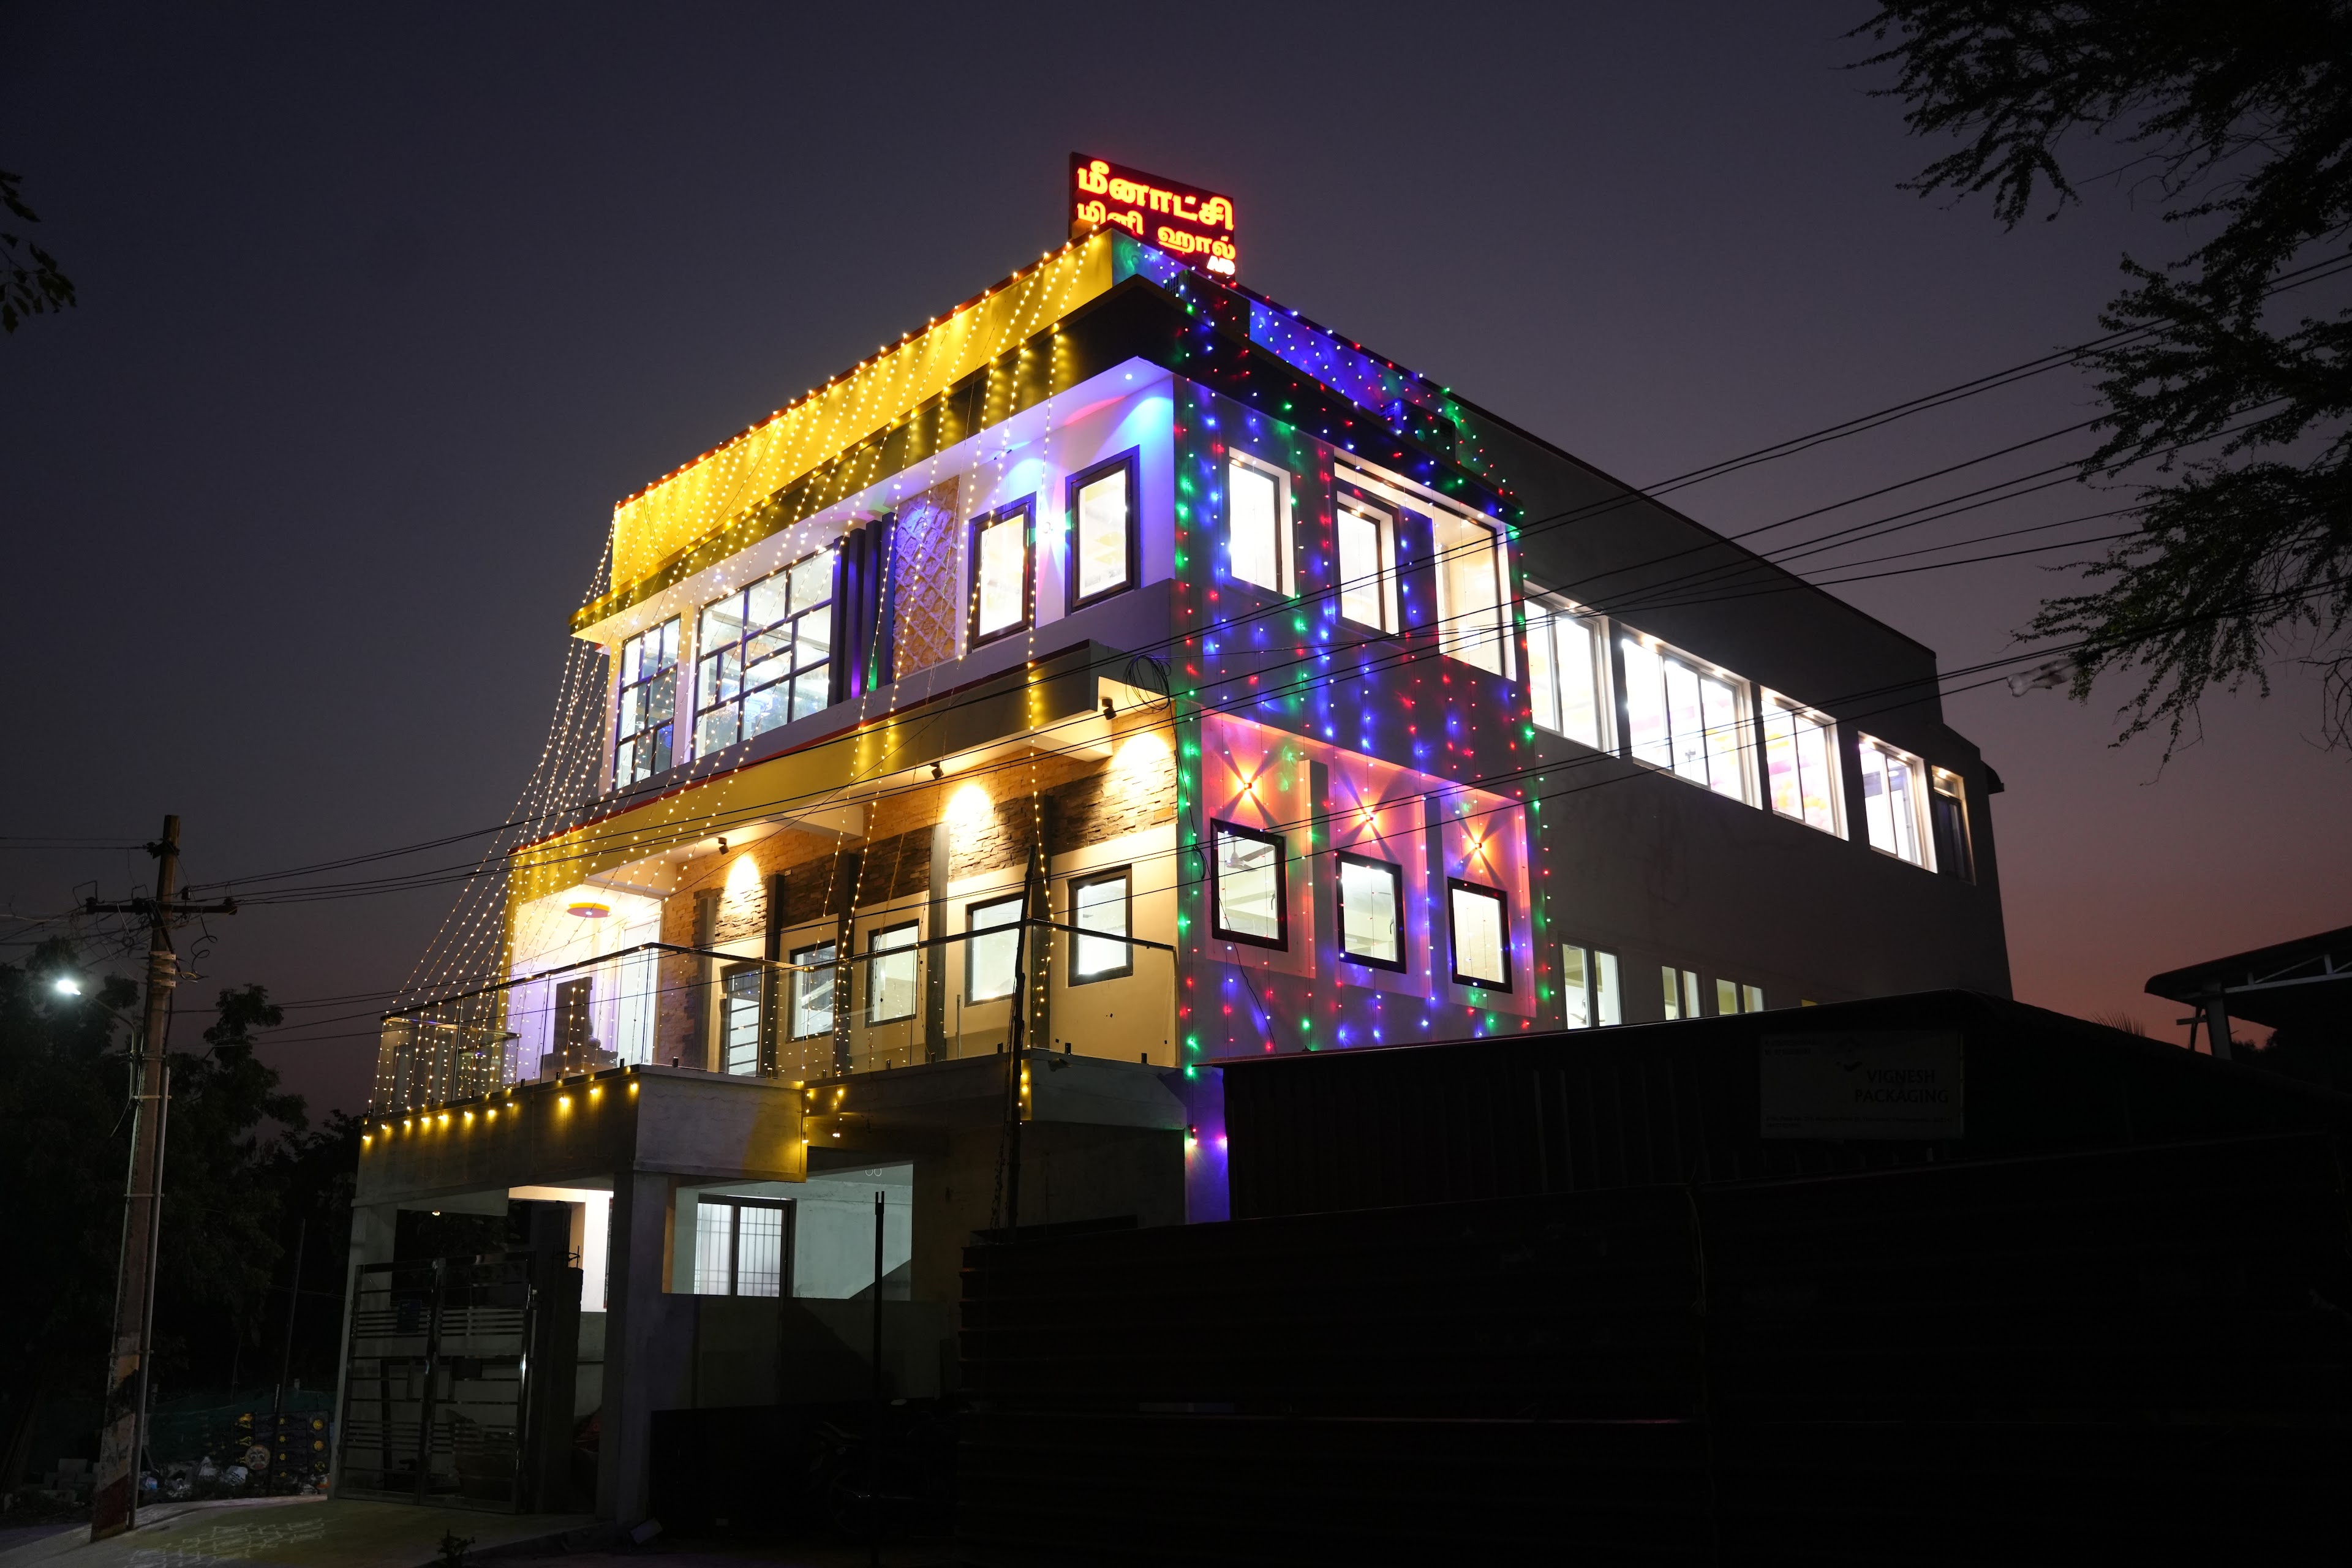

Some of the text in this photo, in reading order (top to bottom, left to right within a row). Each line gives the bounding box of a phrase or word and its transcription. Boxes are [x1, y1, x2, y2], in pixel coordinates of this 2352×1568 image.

[1077, 160, 1234, 230] மீனாட்சி
[1158, 227, 1236, 259] ஹால்
[1867, 1069, 1935, 1083] VIGNESH
[1855, 1088, 1948, 1102] PACKAGING
